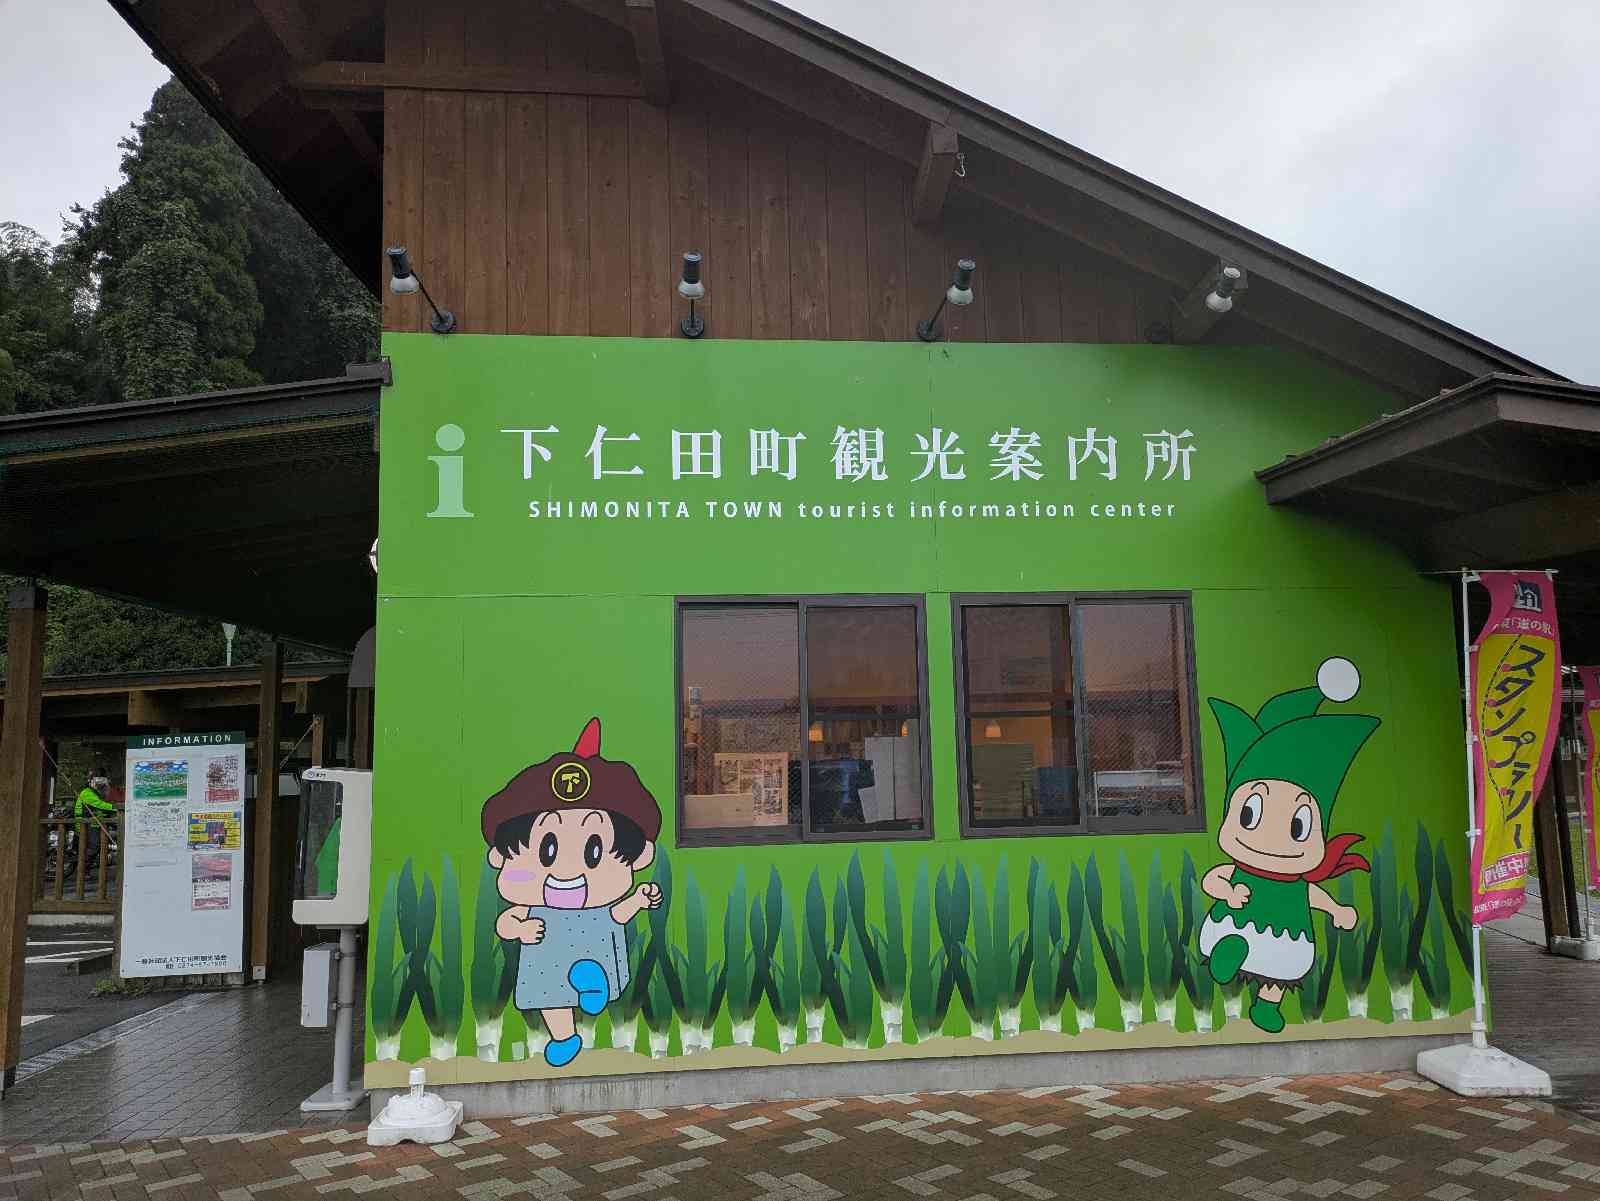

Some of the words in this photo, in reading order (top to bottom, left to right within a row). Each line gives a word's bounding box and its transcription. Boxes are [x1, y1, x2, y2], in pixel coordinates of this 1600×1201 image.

[500, 424, 1197, 483] 下仁田町観光案内所
[528, 500, 690, 519] SHIMONITA
[706, 501, 782, 519] TOWN
[797, 502, 895, 518] tourist
[909, 500, 1074, 518] information
[1090, 502, 1175, 518] center
[142, 734, 233, 747] INFORMATION
[1484, 644, 1546, 849] スタンプラリー
